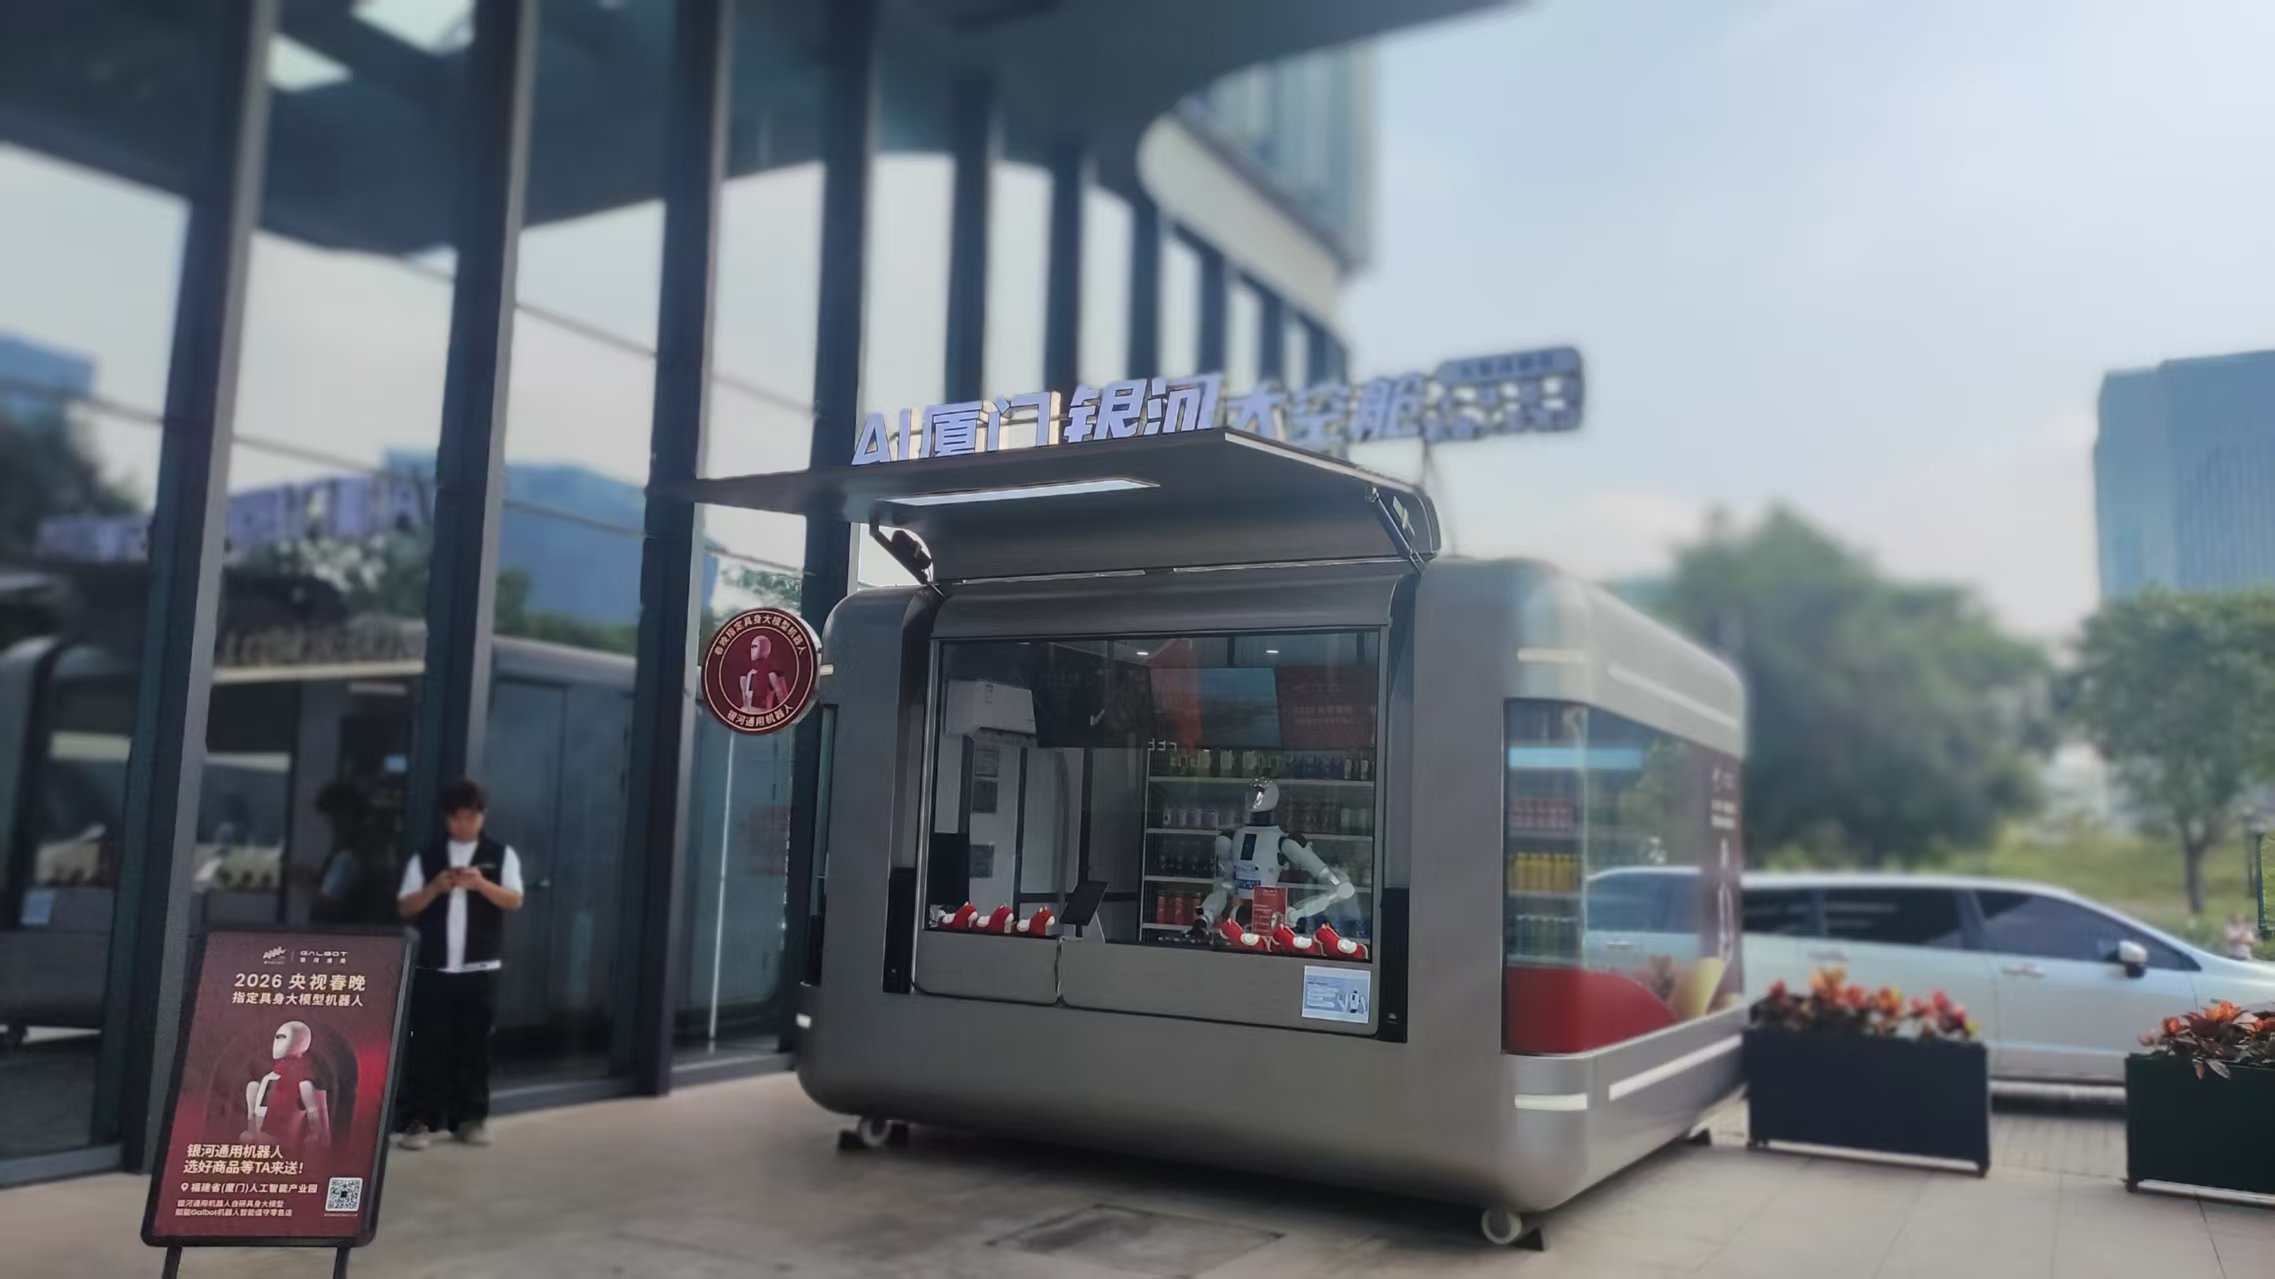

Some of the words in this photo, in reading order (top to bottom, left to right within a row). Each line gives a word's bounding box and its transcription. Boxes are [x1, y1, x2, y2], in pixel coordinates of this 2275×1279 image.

[727, 704, 794, 727] 银河通用机器人
[235, 973, 282, 989] 2026
[289, 973, 366, 991] 央视春晚
[232, 991, 364, 1007] 指定具身大模型机器人
[187, 1144, 283, 1158] 银河通用机器人
[183, 1159, 304, 1175] 选好商品等TA来送!
